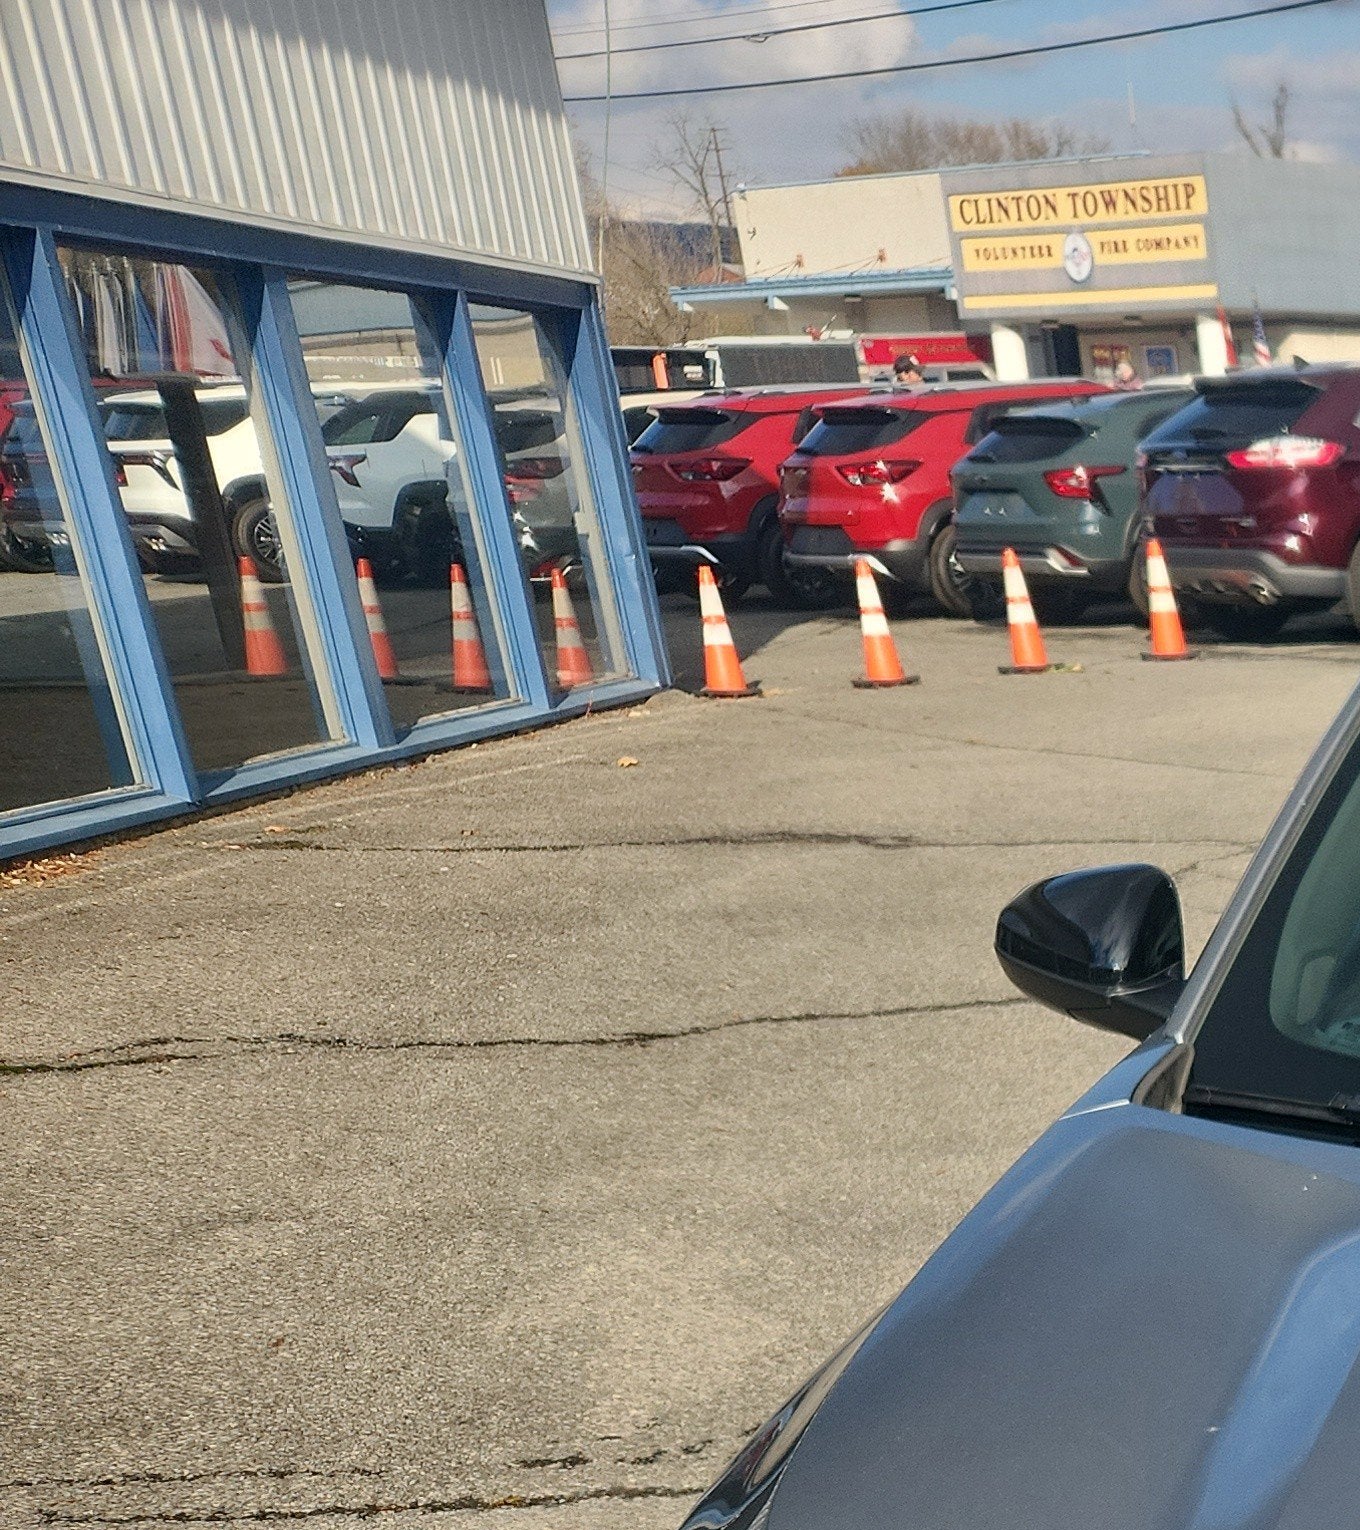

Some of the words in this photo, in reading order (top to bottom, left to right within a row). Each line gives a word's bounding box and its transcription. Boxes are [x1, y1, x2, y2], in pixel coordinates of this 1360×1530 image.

[959, 193, 1058, 225] CLINTON
[1067, 182, 1197, 219] TOWNSHIP
[974, 244, 1054, 261] VOLUNTEER
[1100, 239, 1129, 255] FIRE
[1136, 234, 1200, 252] COMPANY
